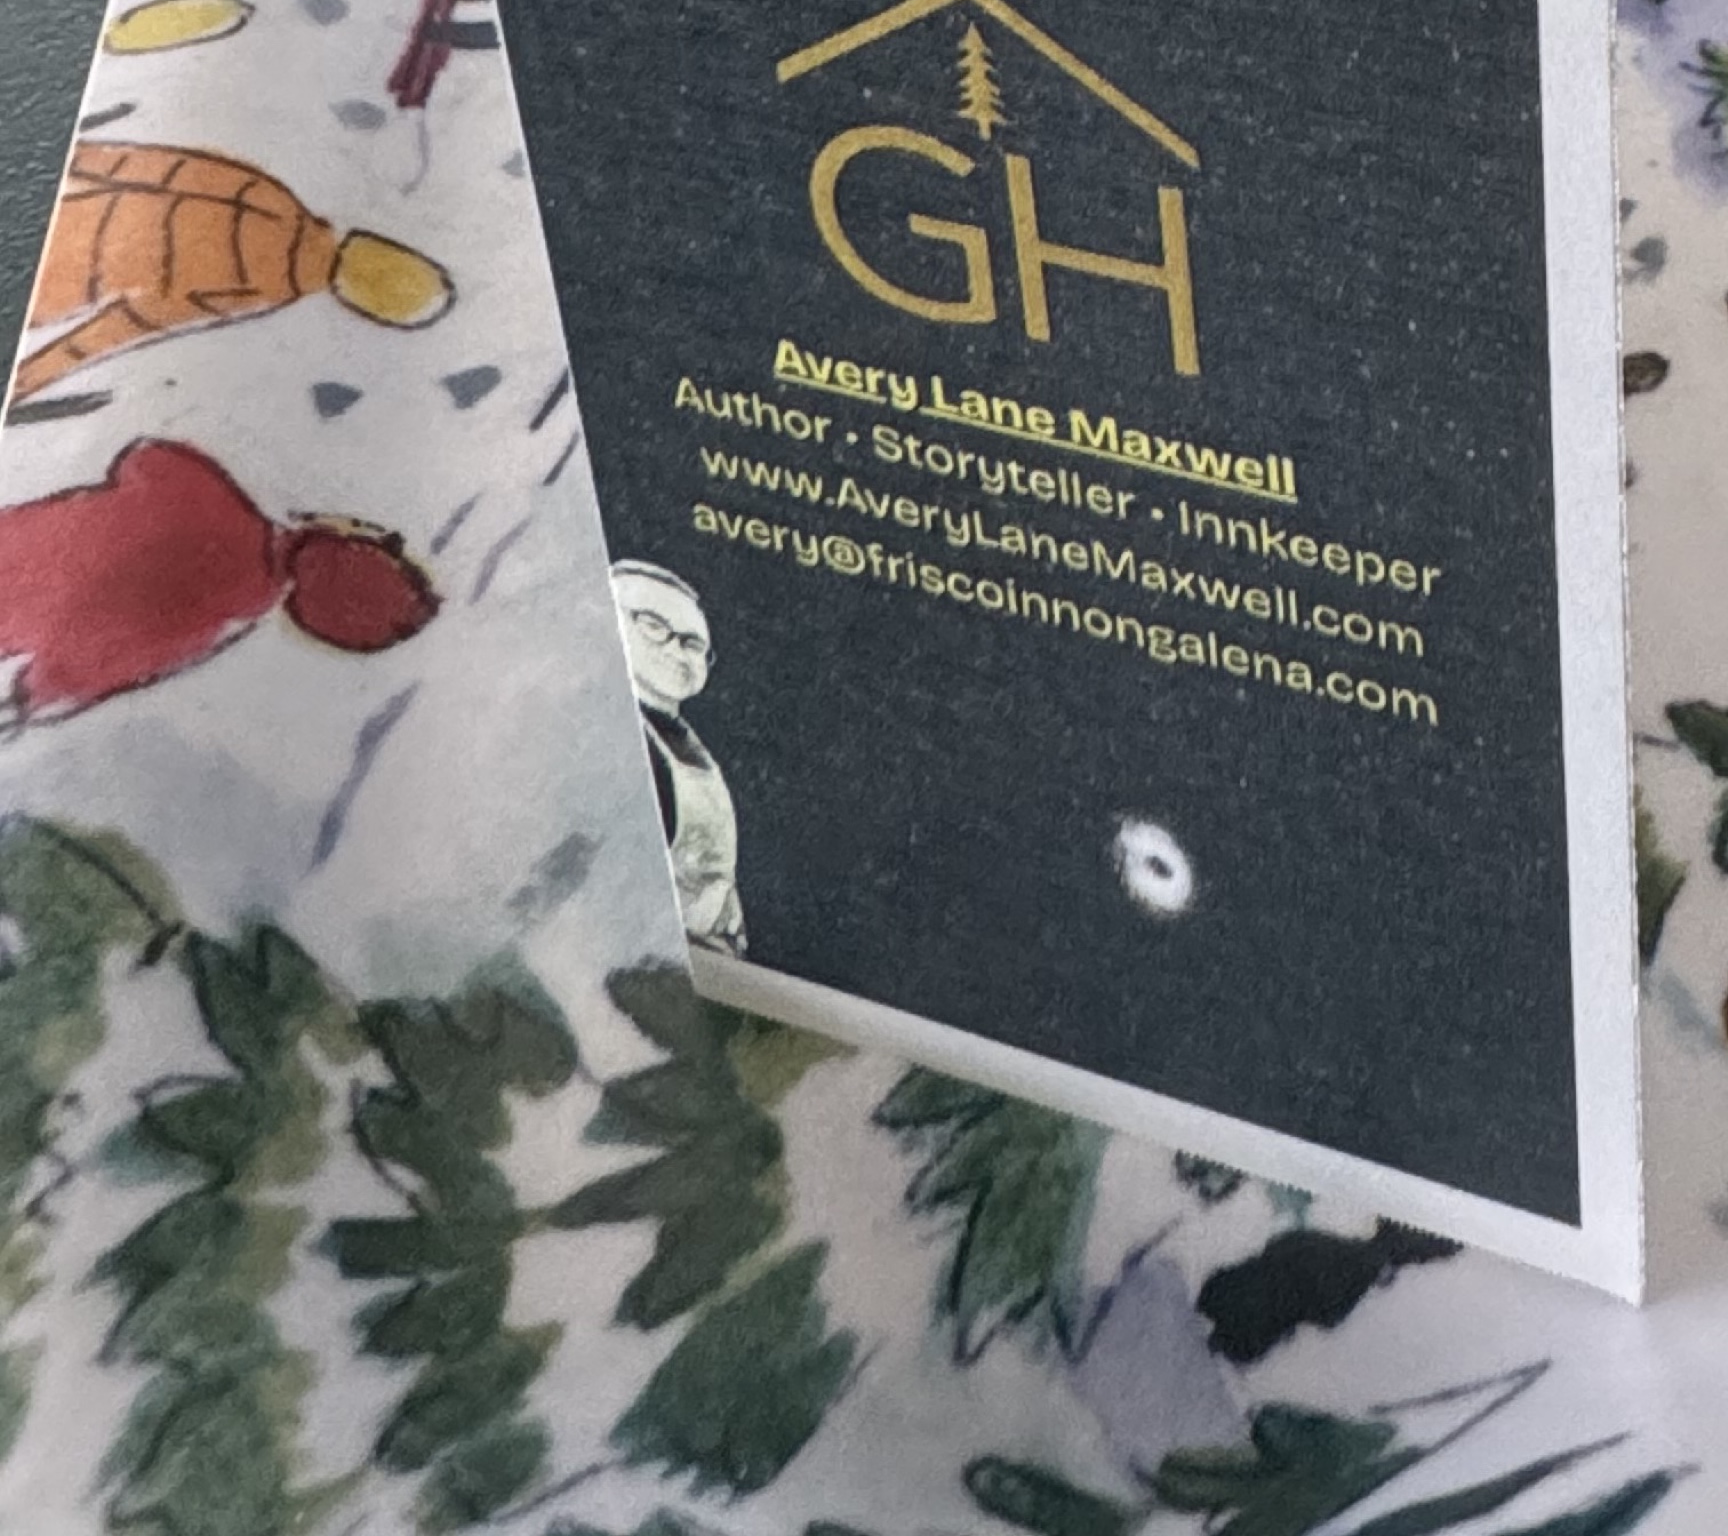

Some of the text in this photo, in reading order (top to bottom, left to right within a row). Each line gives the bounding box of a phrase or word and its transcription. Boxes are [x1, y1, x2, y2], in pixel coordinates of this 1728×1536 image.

[808, 124, 1201, 377] GH
[673, 375, 1444, 600] Author Storyteller Innkeeper
[773, 337, 1298, 503] Avery Lane Maxwell
[690, 501, 1441, 728] avery@friscoinnongalena.com
[700, 446, 1428, 659] www.AveryLaneMaxwell.com
